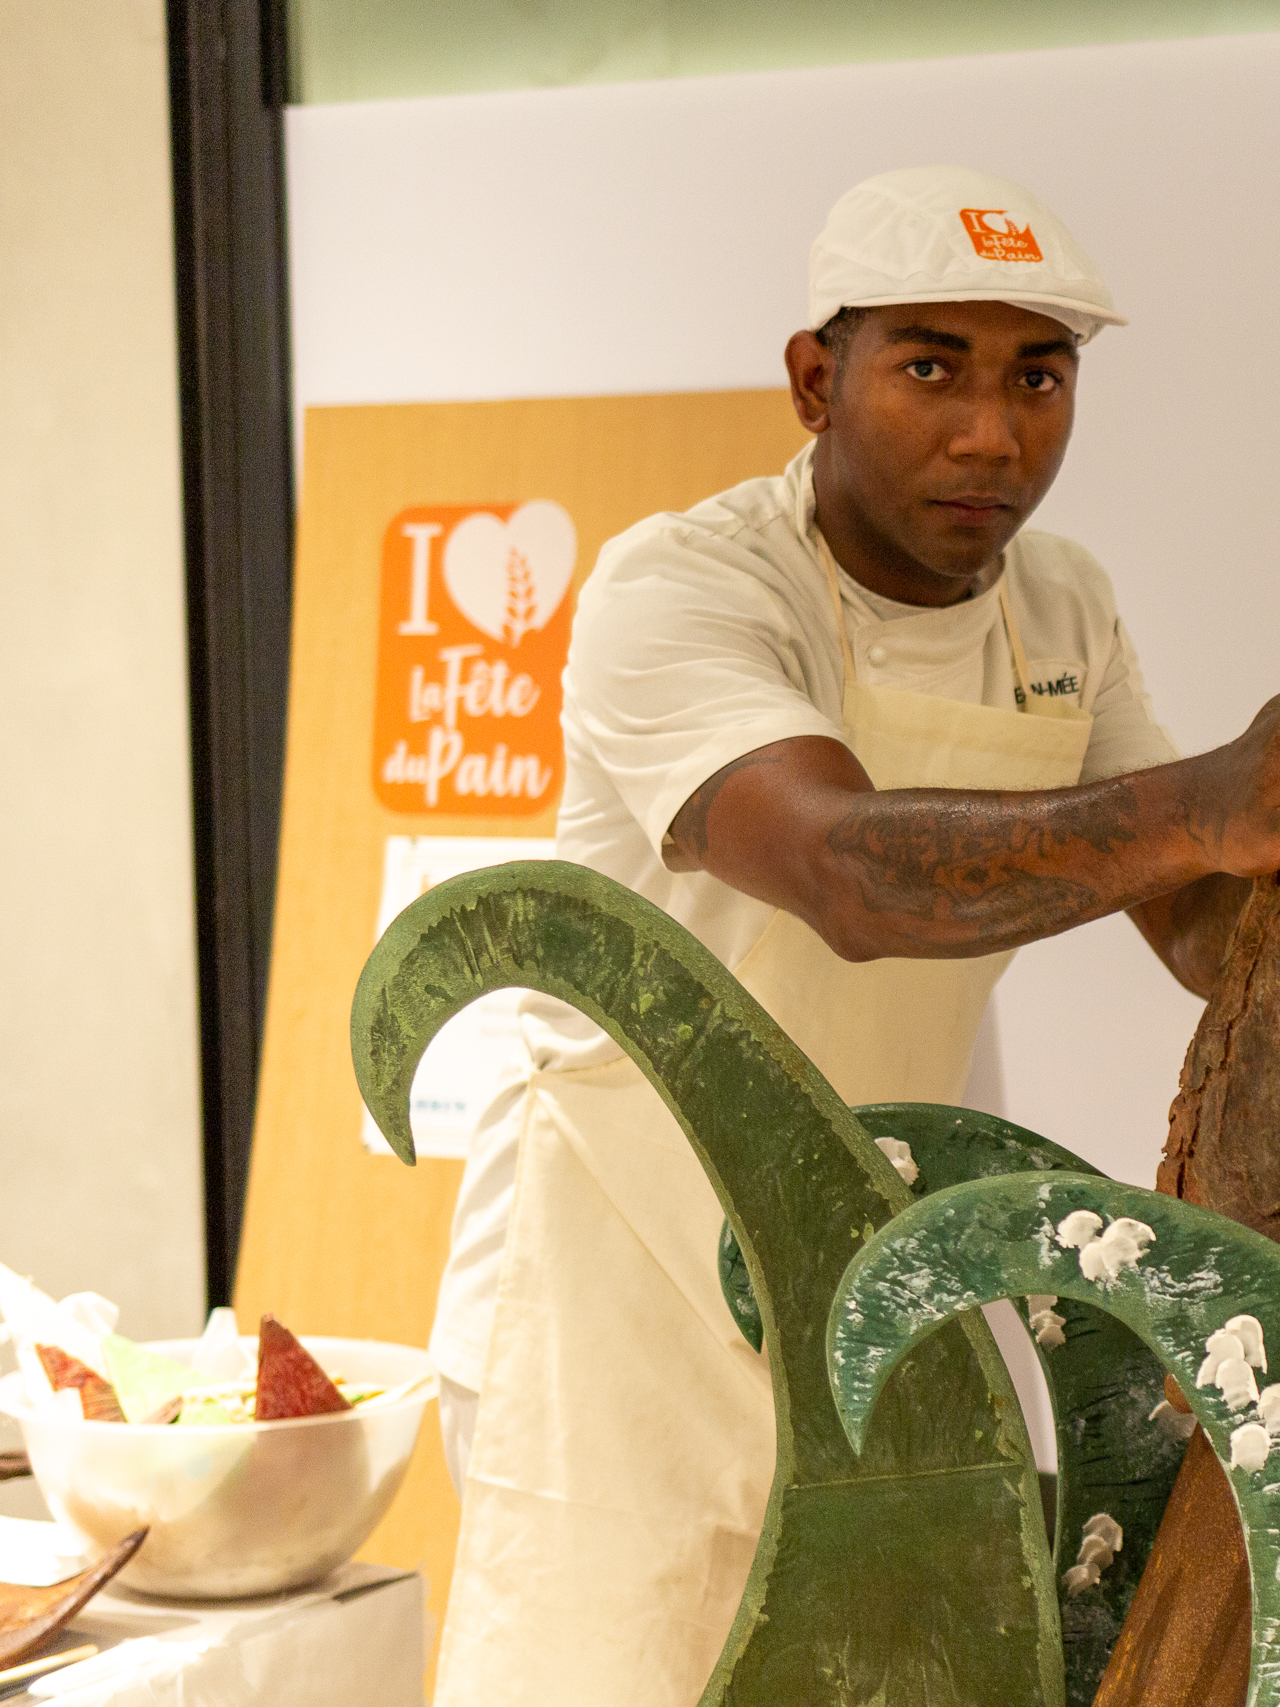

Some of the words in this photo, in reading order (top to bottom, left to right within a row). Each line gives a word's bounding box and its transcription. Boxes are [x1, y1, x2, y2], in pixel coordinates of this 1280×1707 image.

[966, 211, 987, 233] I
[397, 522, 443, 636] I
[438, 643, 542, 735] Fête
[382, 739, 429, 785] du
[425, 724, 553, 808] Pain
